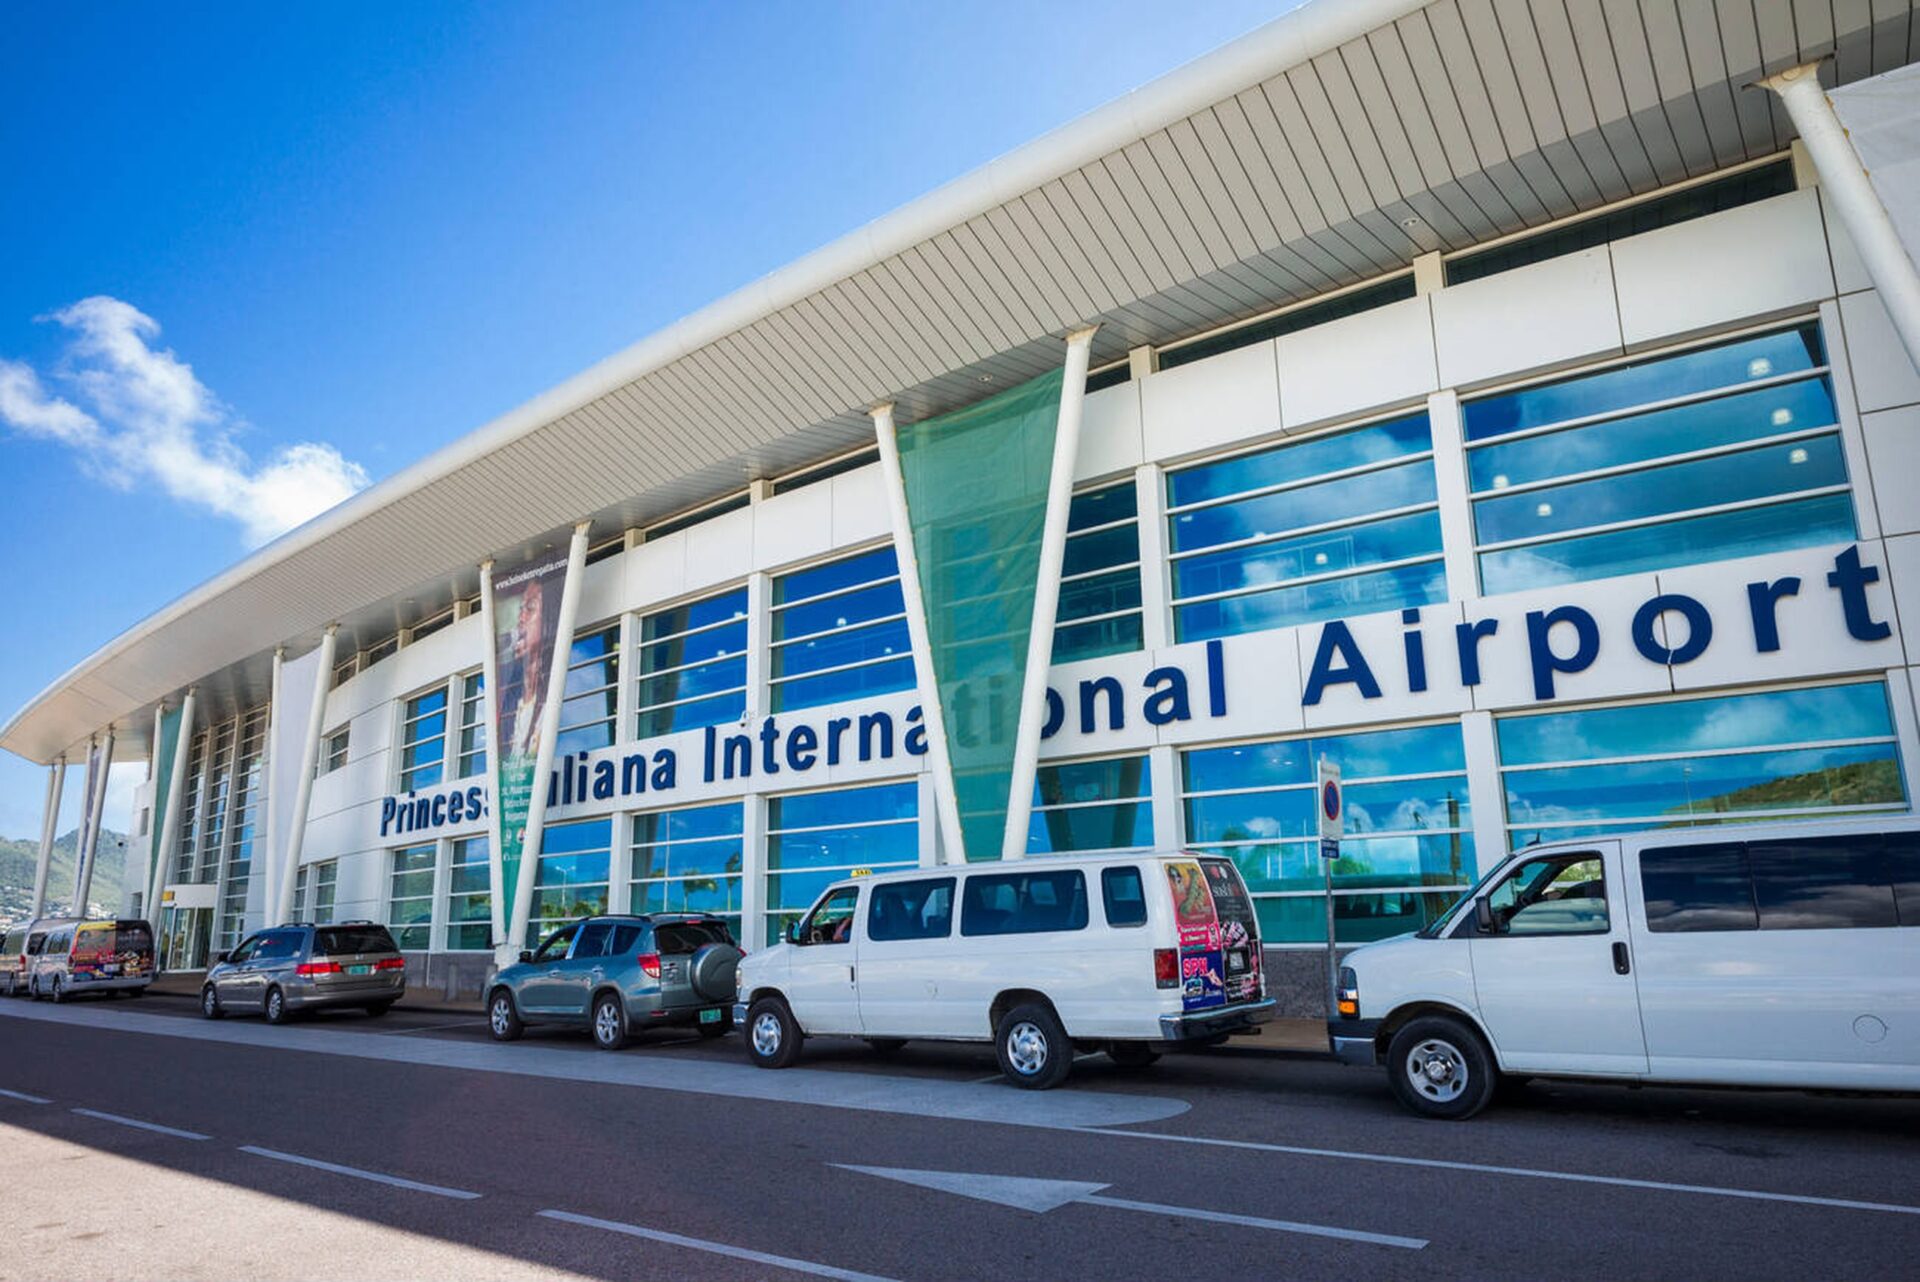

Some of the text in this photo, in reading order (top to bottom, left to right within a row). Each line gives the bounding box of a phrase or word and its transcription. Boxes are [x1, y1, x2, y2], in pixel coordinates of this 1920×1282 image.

[380, 786, 489, 837] Princes
[547, 748, 677, 808] liana
[1302, 544, 1892, 706] Airport
